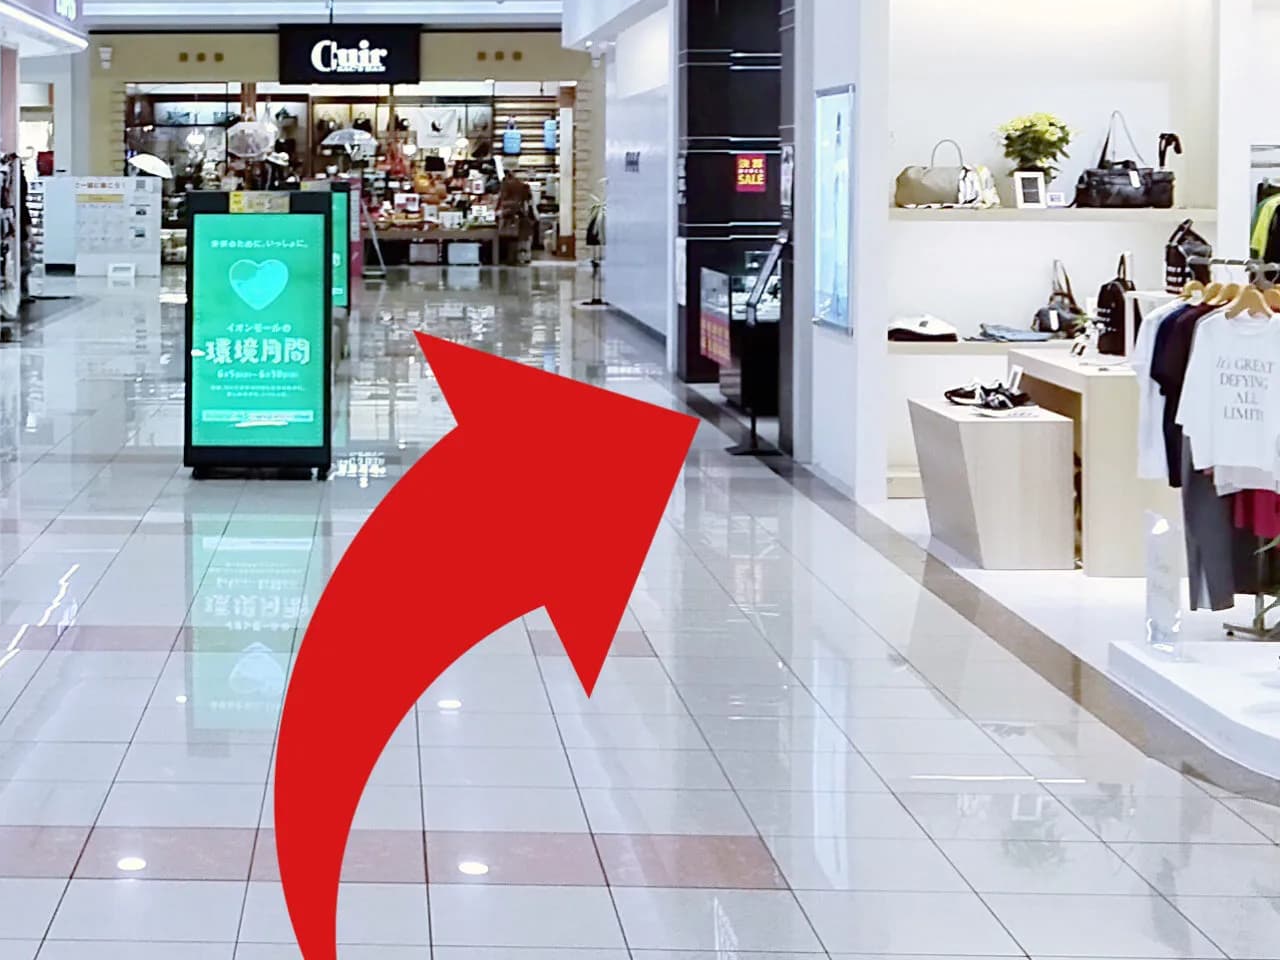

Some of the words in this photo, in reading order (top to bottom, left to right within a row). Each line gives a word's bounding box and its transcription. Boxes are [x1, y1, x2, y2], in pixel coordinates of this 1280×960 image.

[311, 39, 388, 72] Cuir
[737, 173, 765, 185] SALE
[204, 336, 311, 365] 環境月間
[1234, 358, 1275, 374] GREAT
